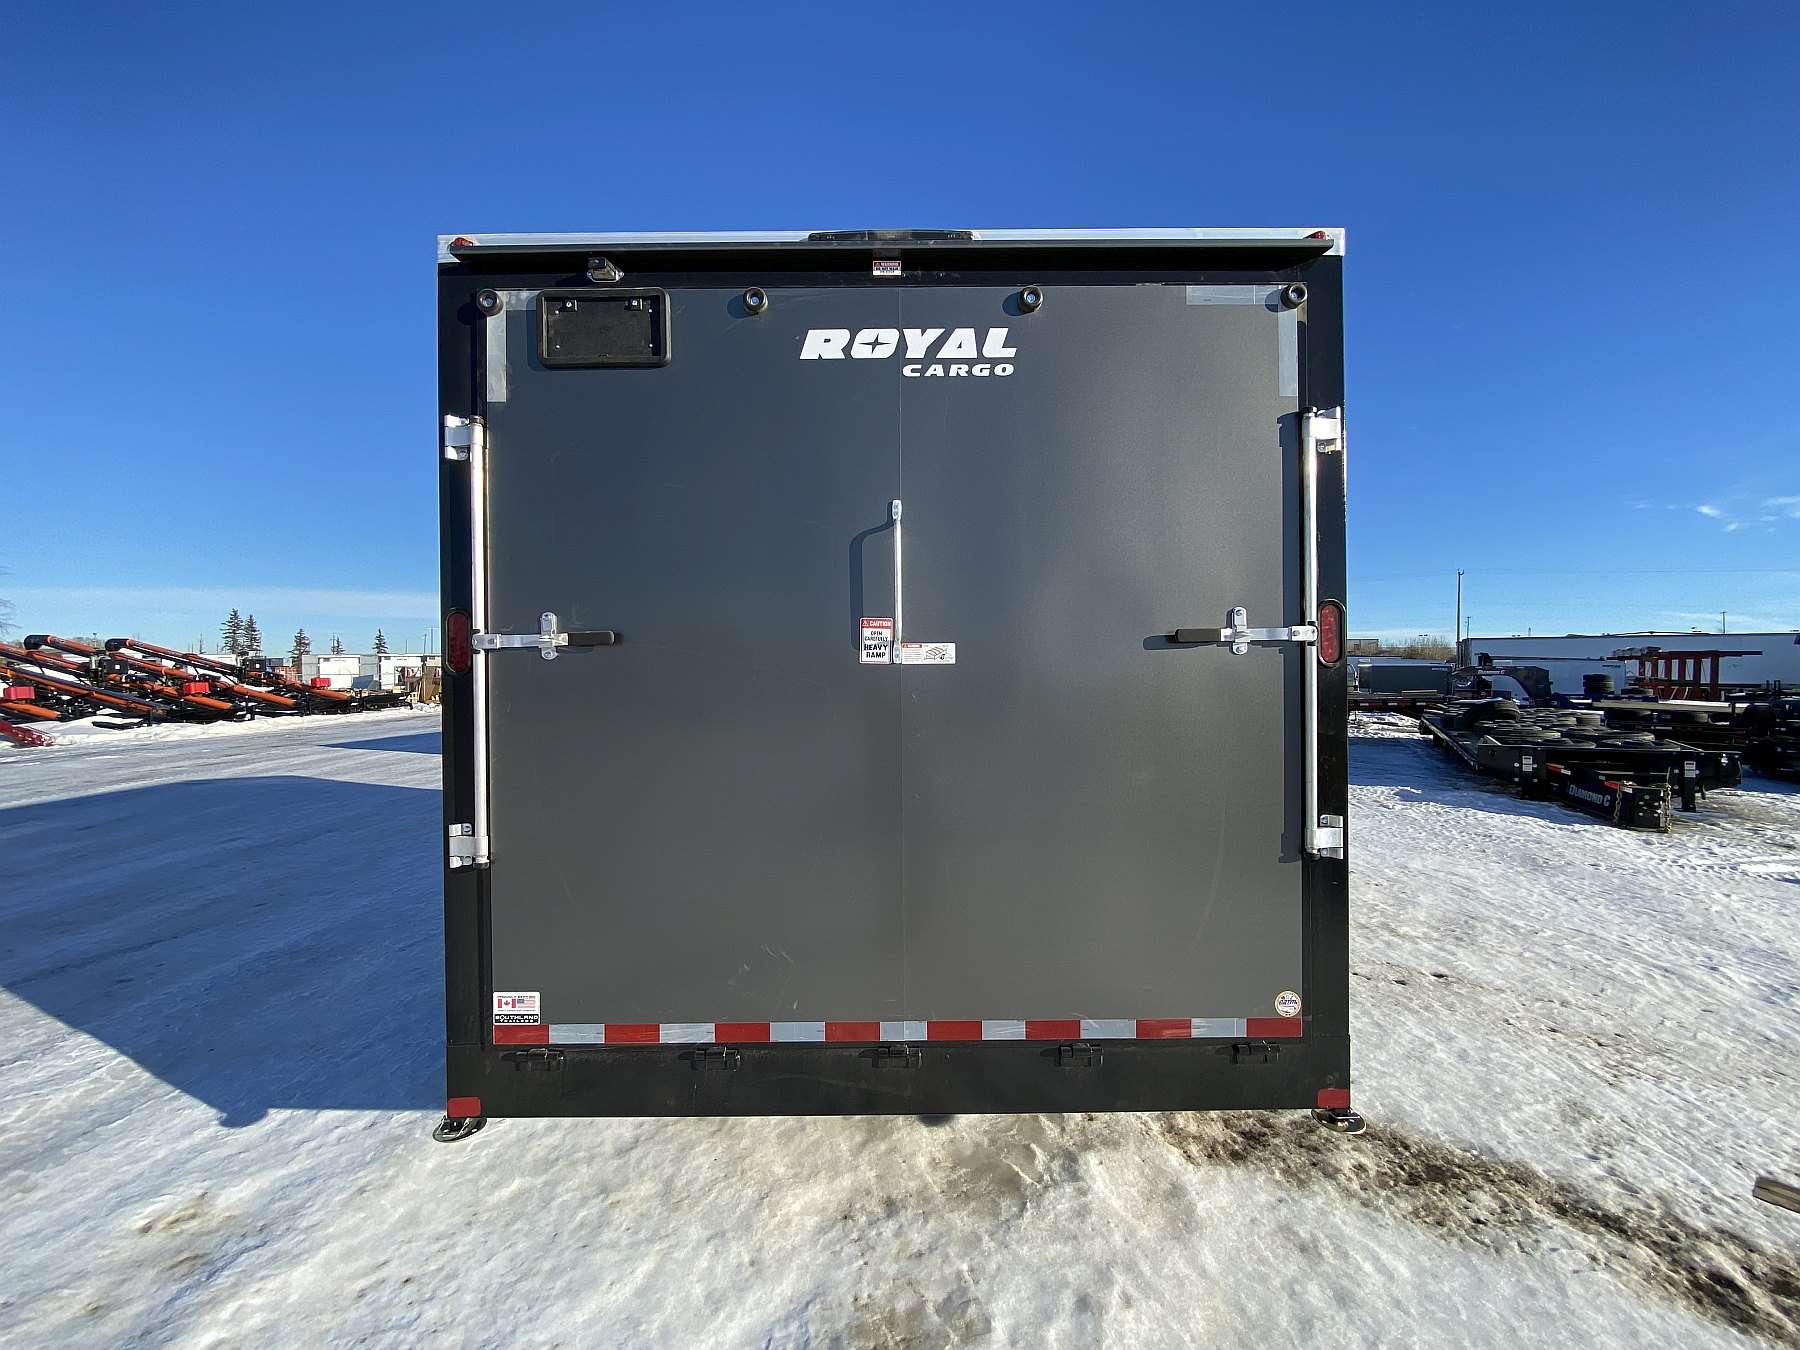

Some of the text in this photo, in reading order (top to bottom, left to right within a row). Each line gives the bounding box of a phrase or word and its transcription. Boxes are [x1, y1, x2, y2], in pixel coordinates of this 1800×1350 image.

[799, 327, 1017, 360] ROYAL
[902, 363, 1015, 377] CARGO
[1569, 784, 1611, 807] DIAMOND C
